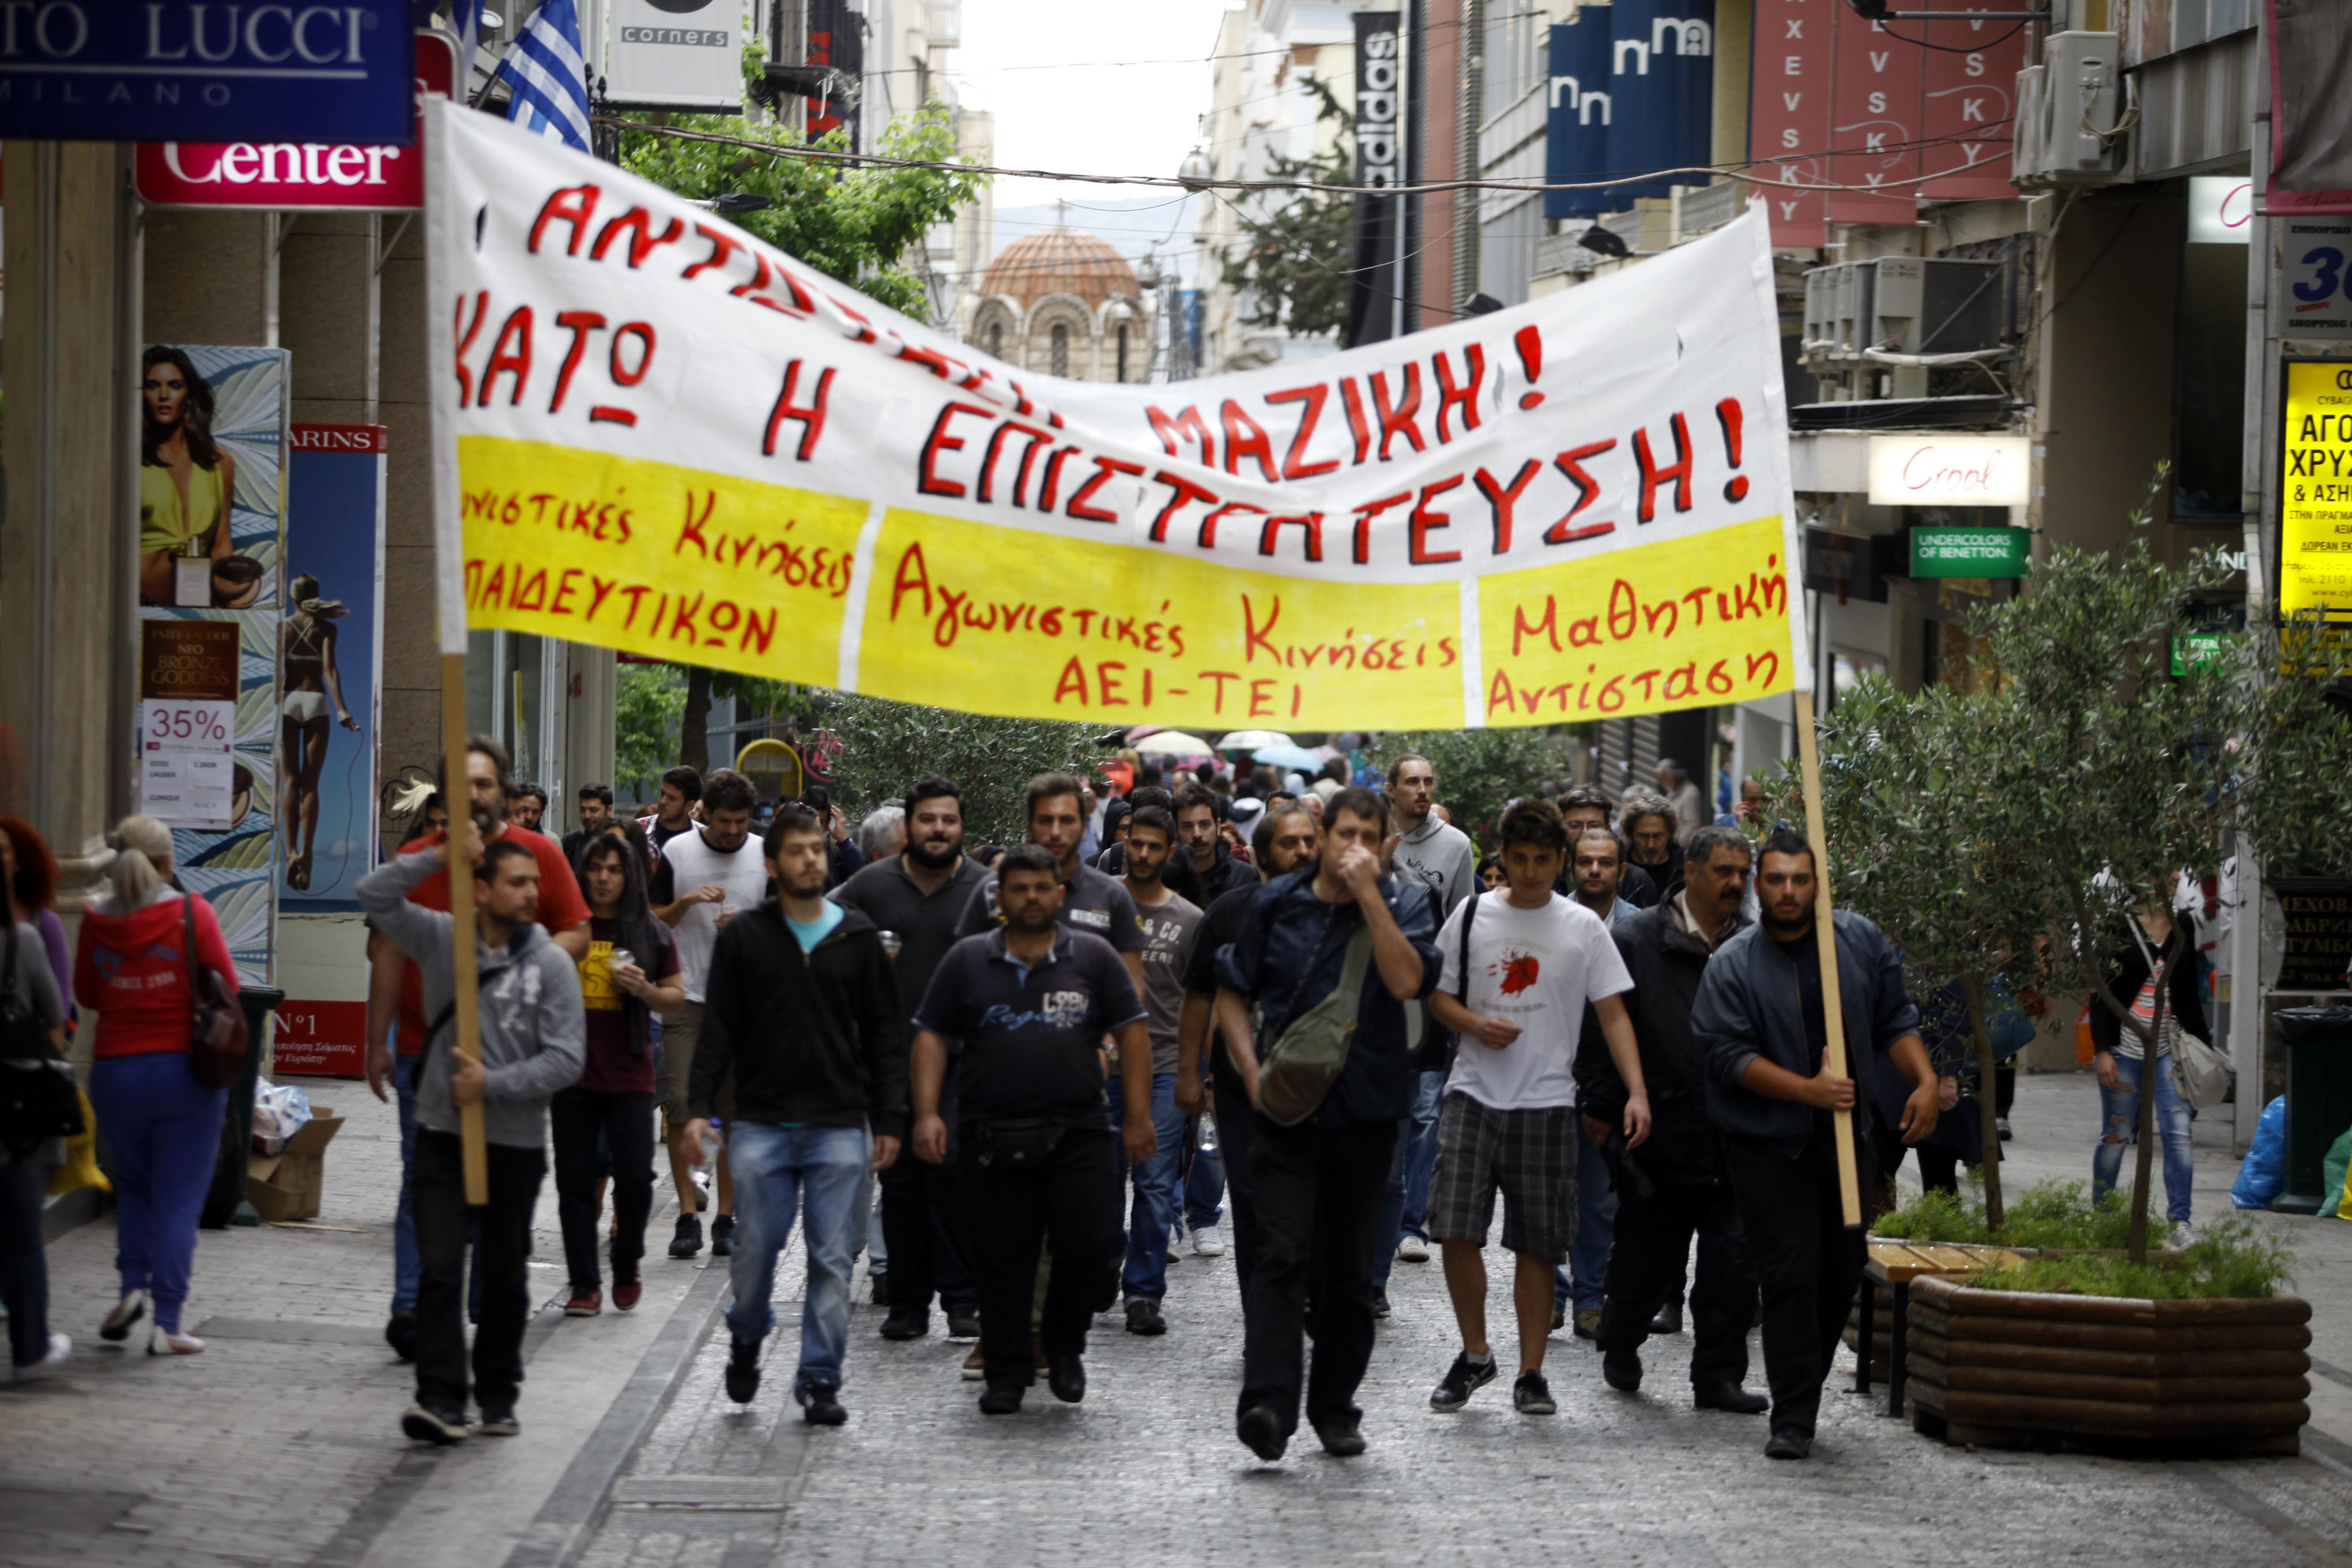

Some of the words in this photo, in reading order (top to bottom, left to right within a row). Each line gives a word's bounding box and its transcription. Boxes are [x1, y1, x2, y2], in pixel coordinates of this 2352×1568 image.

[624, 28, 728, 46] corners
[1356, 32, 1397, 197] adidas
[164, 141, 400, 185] Center
[2292, 246, 2352, 302] 3
[2313, 485, 2352, 503] ΑΣΗ
[1918, 534, 2011, 546] UNDERCOLORS
[1918, 547, 1938, 558] OF
[889, 541, 1185, 647] Αγωνιστικές
[1241, 592, 1457, 670] Κινήσεις
[1512, 554, 1786, 657] Μαθητική
[1488, 650, 1778, 718] Αντίσταση
[152, 709, 225, 740] 35%
